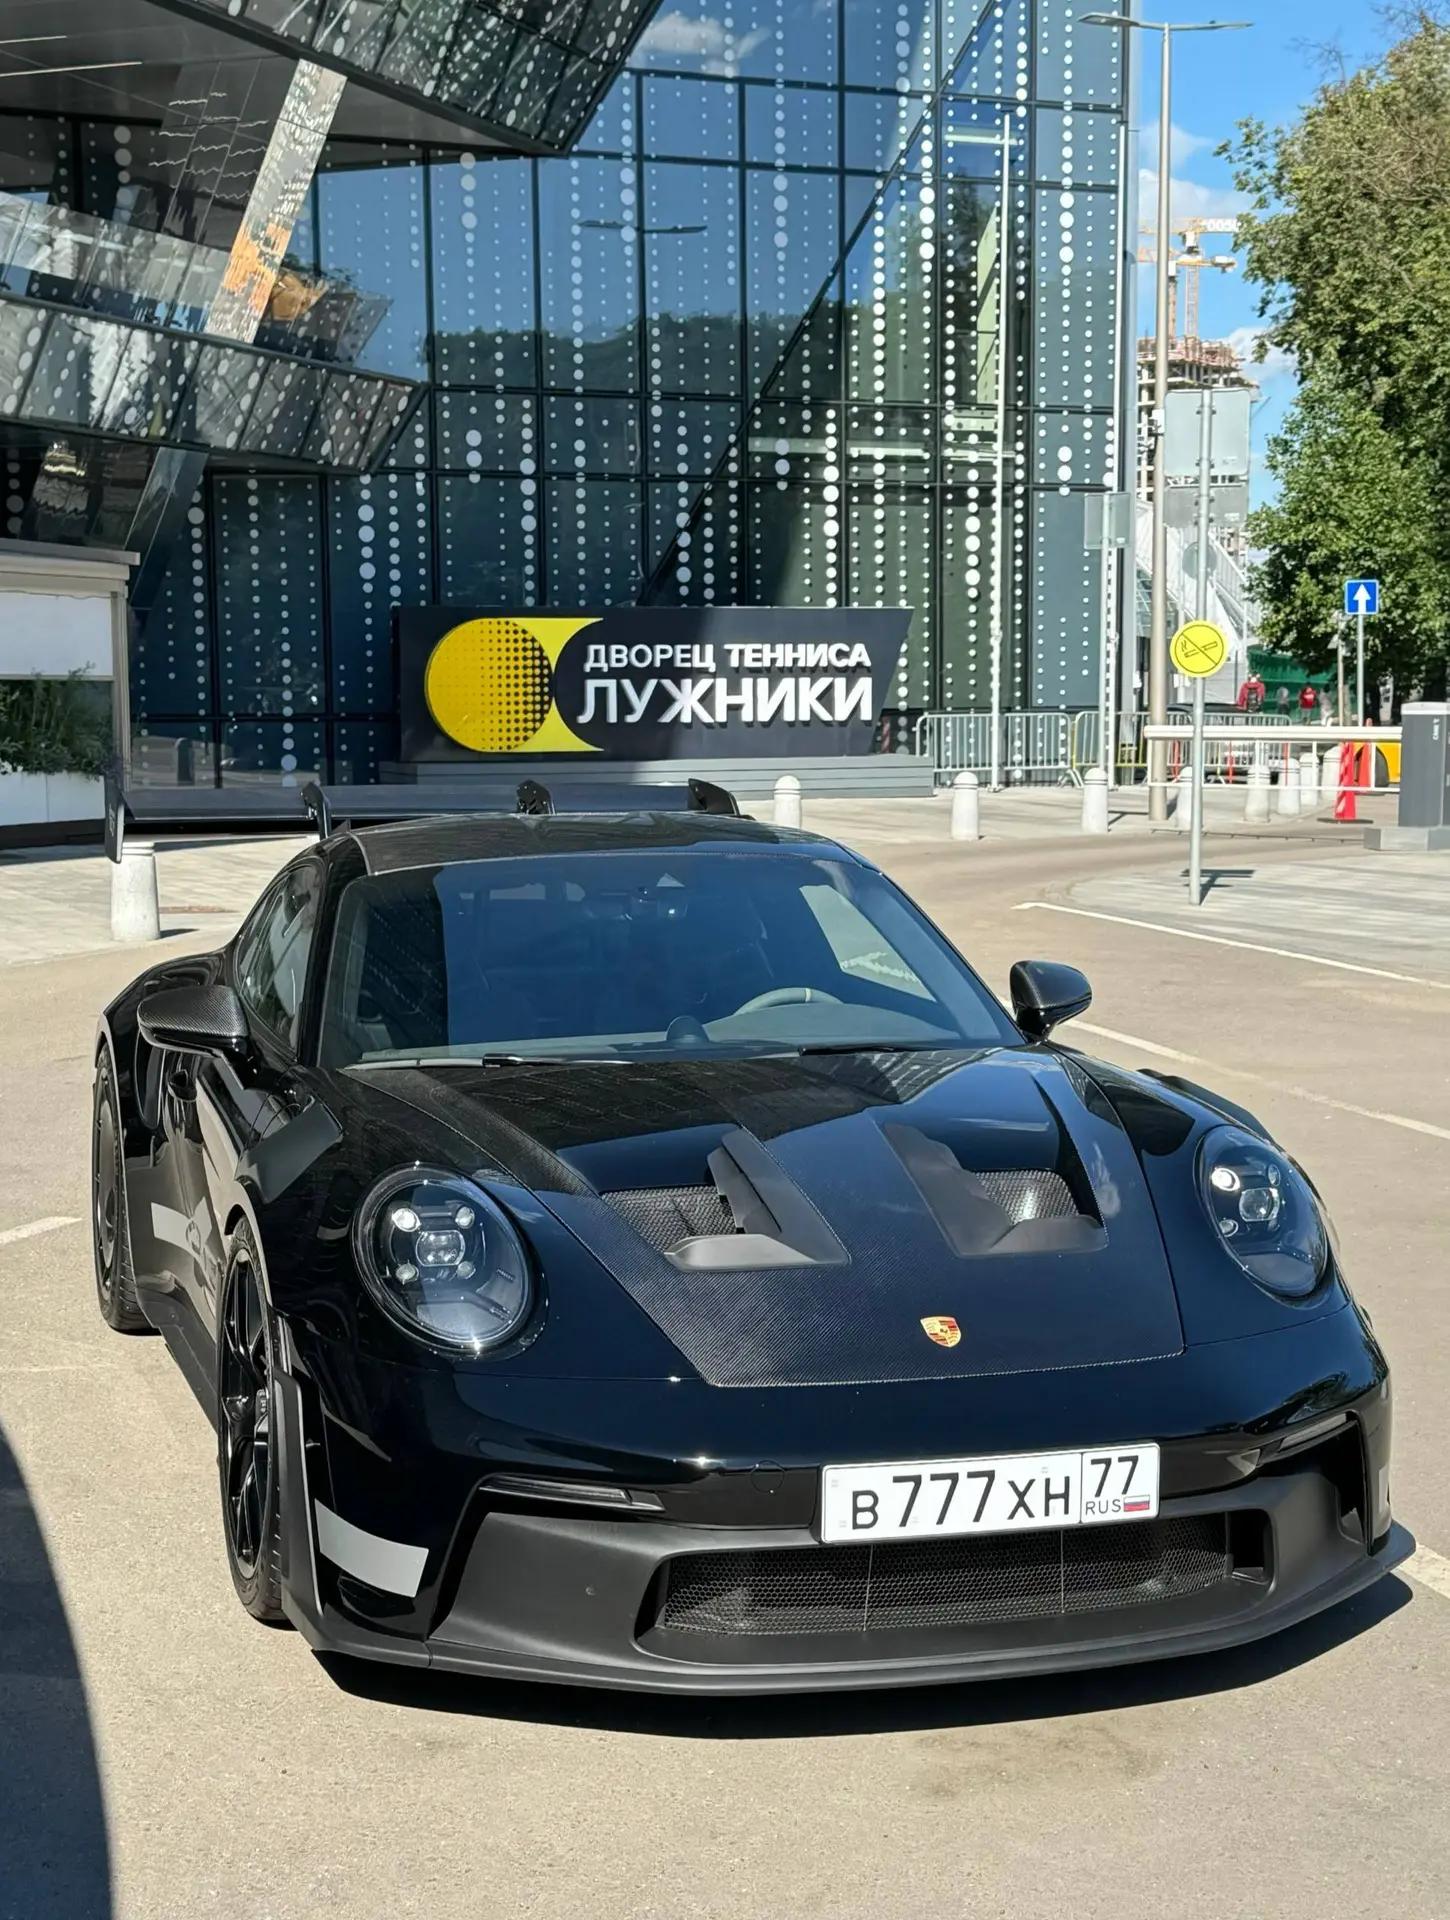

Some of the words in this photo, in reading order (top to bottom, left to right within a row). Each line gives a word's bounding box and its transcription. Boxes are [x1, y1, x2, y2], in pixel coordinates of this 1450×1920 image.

[583, 644, 716, 673] ДВОРЕЦ
[724, 643, 872, 668] ТЕННИСА
[577, 677, 873, 724] ЛУЖНИКИ
[1090, 1455, 1139, 1498] 77
[1085, 1499, 1122, 1516] RUS
